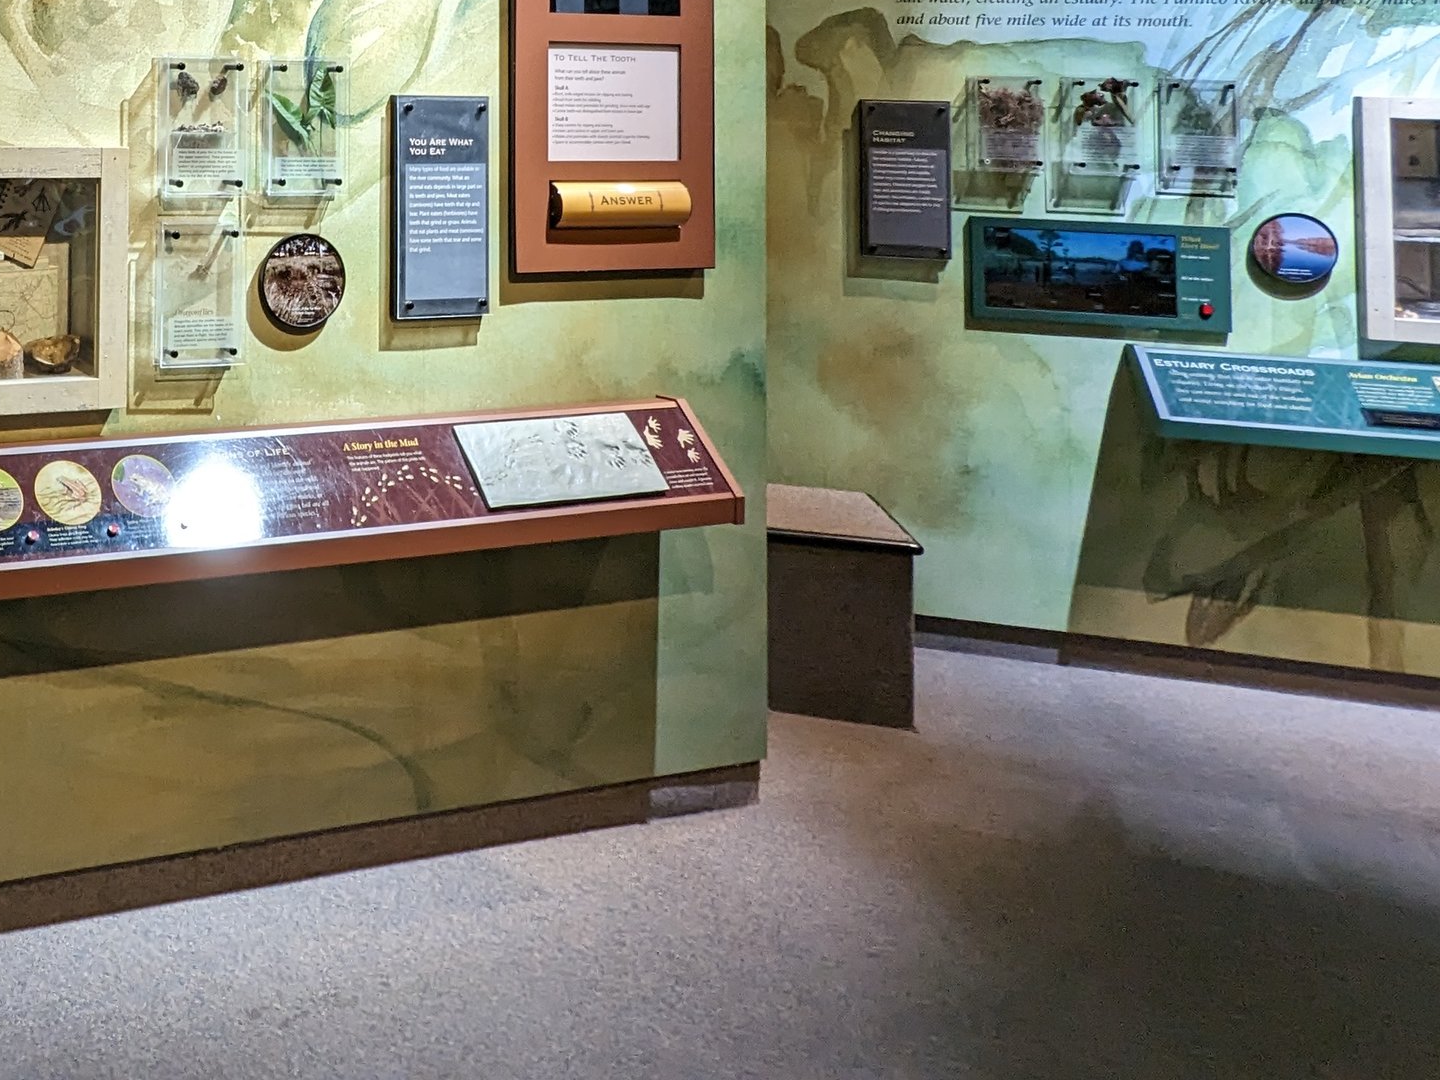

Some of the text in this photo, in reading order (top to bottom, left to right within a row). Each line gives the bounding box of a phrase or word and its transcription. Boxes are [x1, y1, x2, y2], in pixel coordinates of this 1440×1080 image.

[896, 14, 1192, 28] and about five miles wide at its mouth.
[601, 193, 653, 207] ANSWER
[1154, 358, 1316, 376] ESTUARY CROSSROADS
[343, 437, 419, 452] A Story in the Mud
